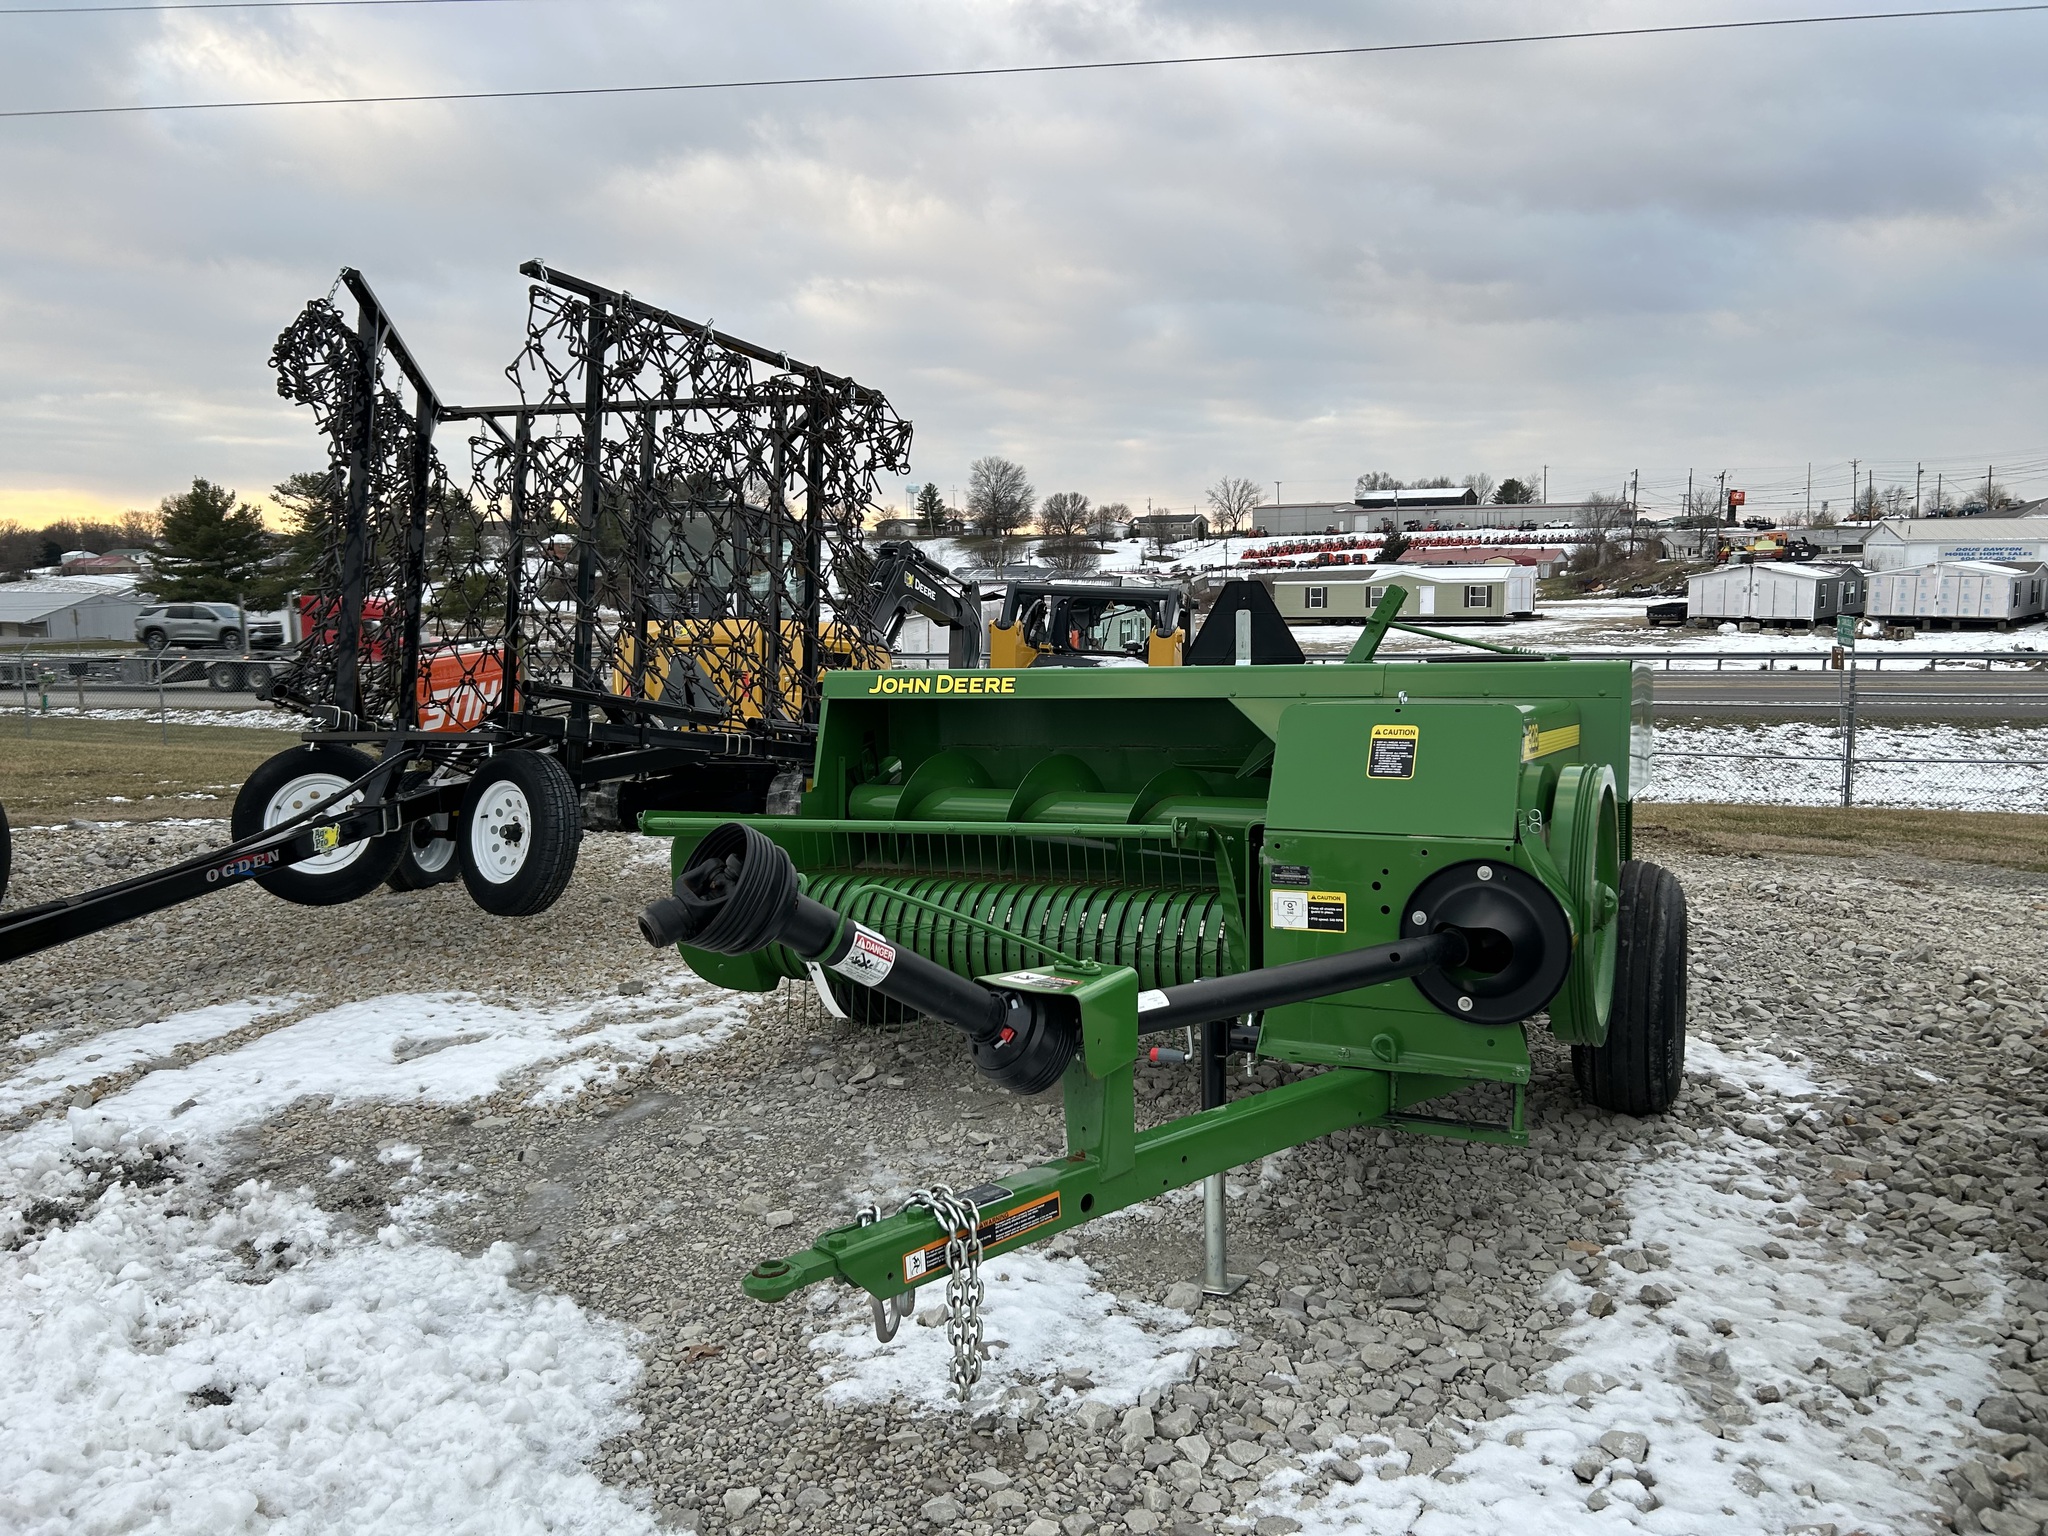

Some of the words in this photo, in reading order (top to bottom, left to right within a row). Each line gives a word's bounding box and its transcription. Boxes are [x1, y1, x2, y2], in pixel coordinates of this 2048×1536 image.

[914, 578, 936, 601] DEERE
[868, 674, 931, 694] JOHN
[935, 674, 1016, 694] DEERE
[422, 679, 502, 732] STIH
[1382, 728, 1416, 736] CAUTION
[315, 838, 329, 849] Pro
[205, 849, 280, 883] OGDEN
[865, 941, 893, 961] DANGER
[982, 1211, 1009, 1227] WARNING
